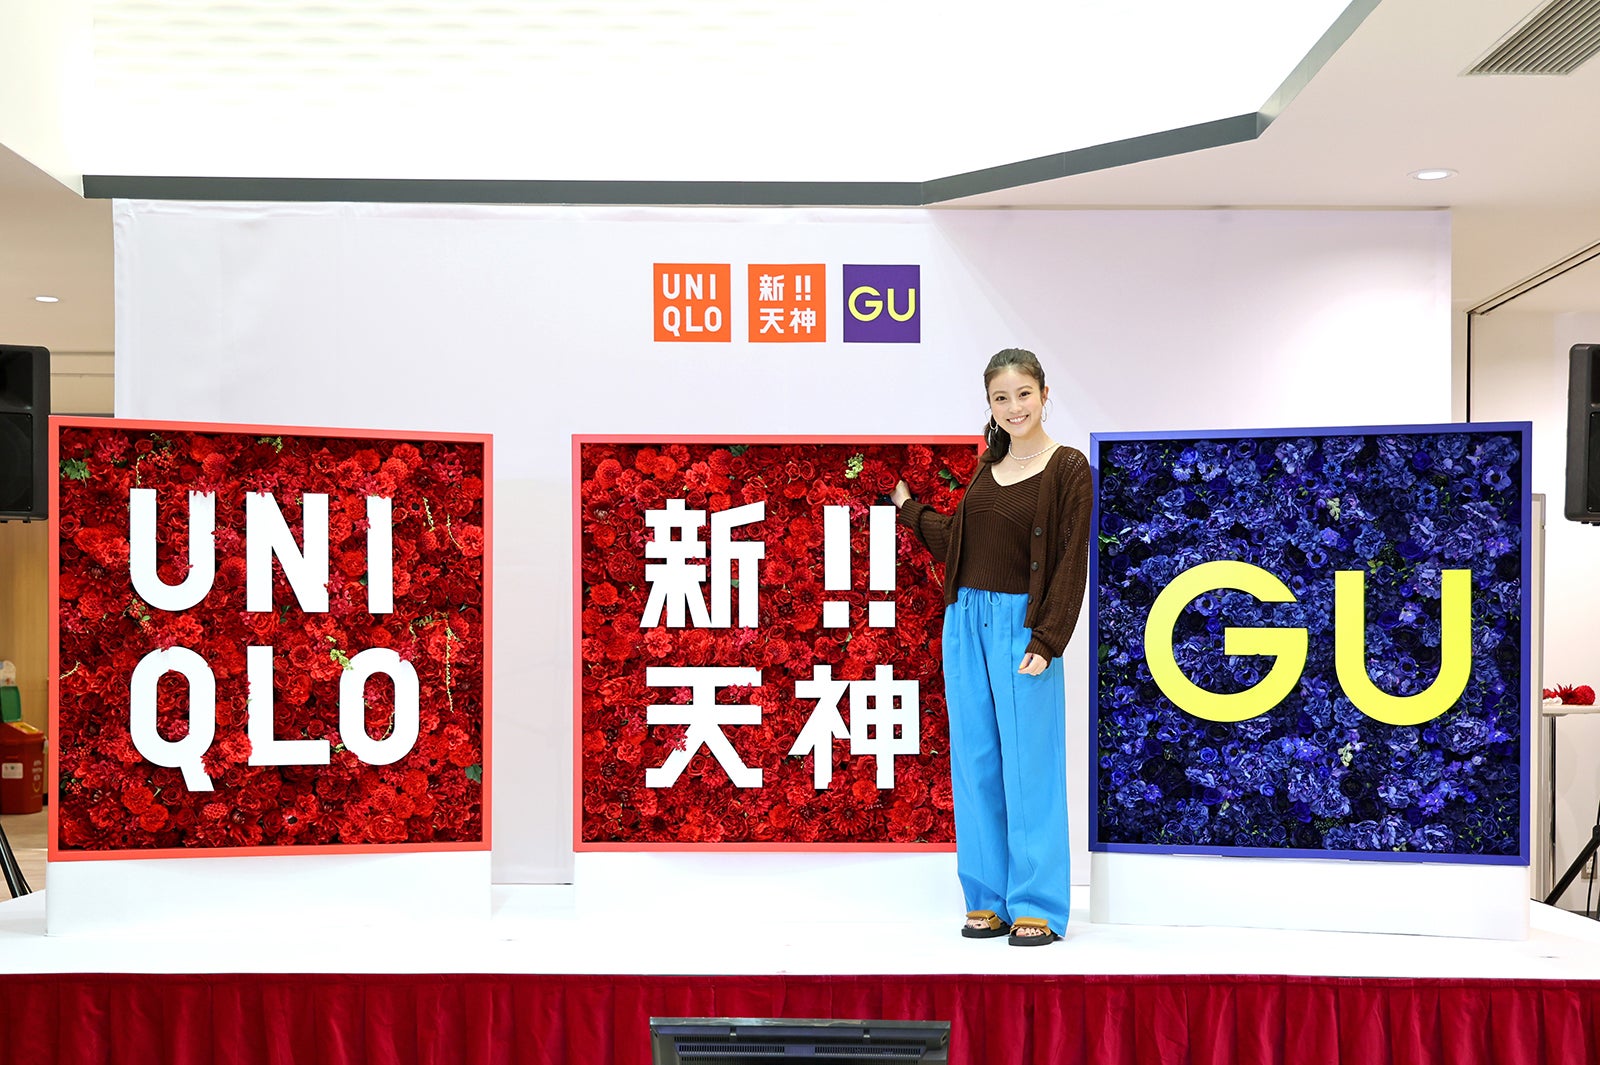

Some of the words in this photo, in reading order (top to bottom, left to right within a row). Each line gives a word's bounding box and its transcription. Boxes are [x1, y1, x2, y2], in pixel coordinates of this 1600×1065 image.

[662, 273, 717, 300] UNI
[662, 305, 722, 337] QLO
[759, 307, 816, 334] 天神
[848, 285, 916, 322] GU
[129, 487, 394, 614] UNI
[1144, 560, 1472, 726] GU
[130, 645, 420, 792] QLO
[645, 664, 921, 790] 天神
